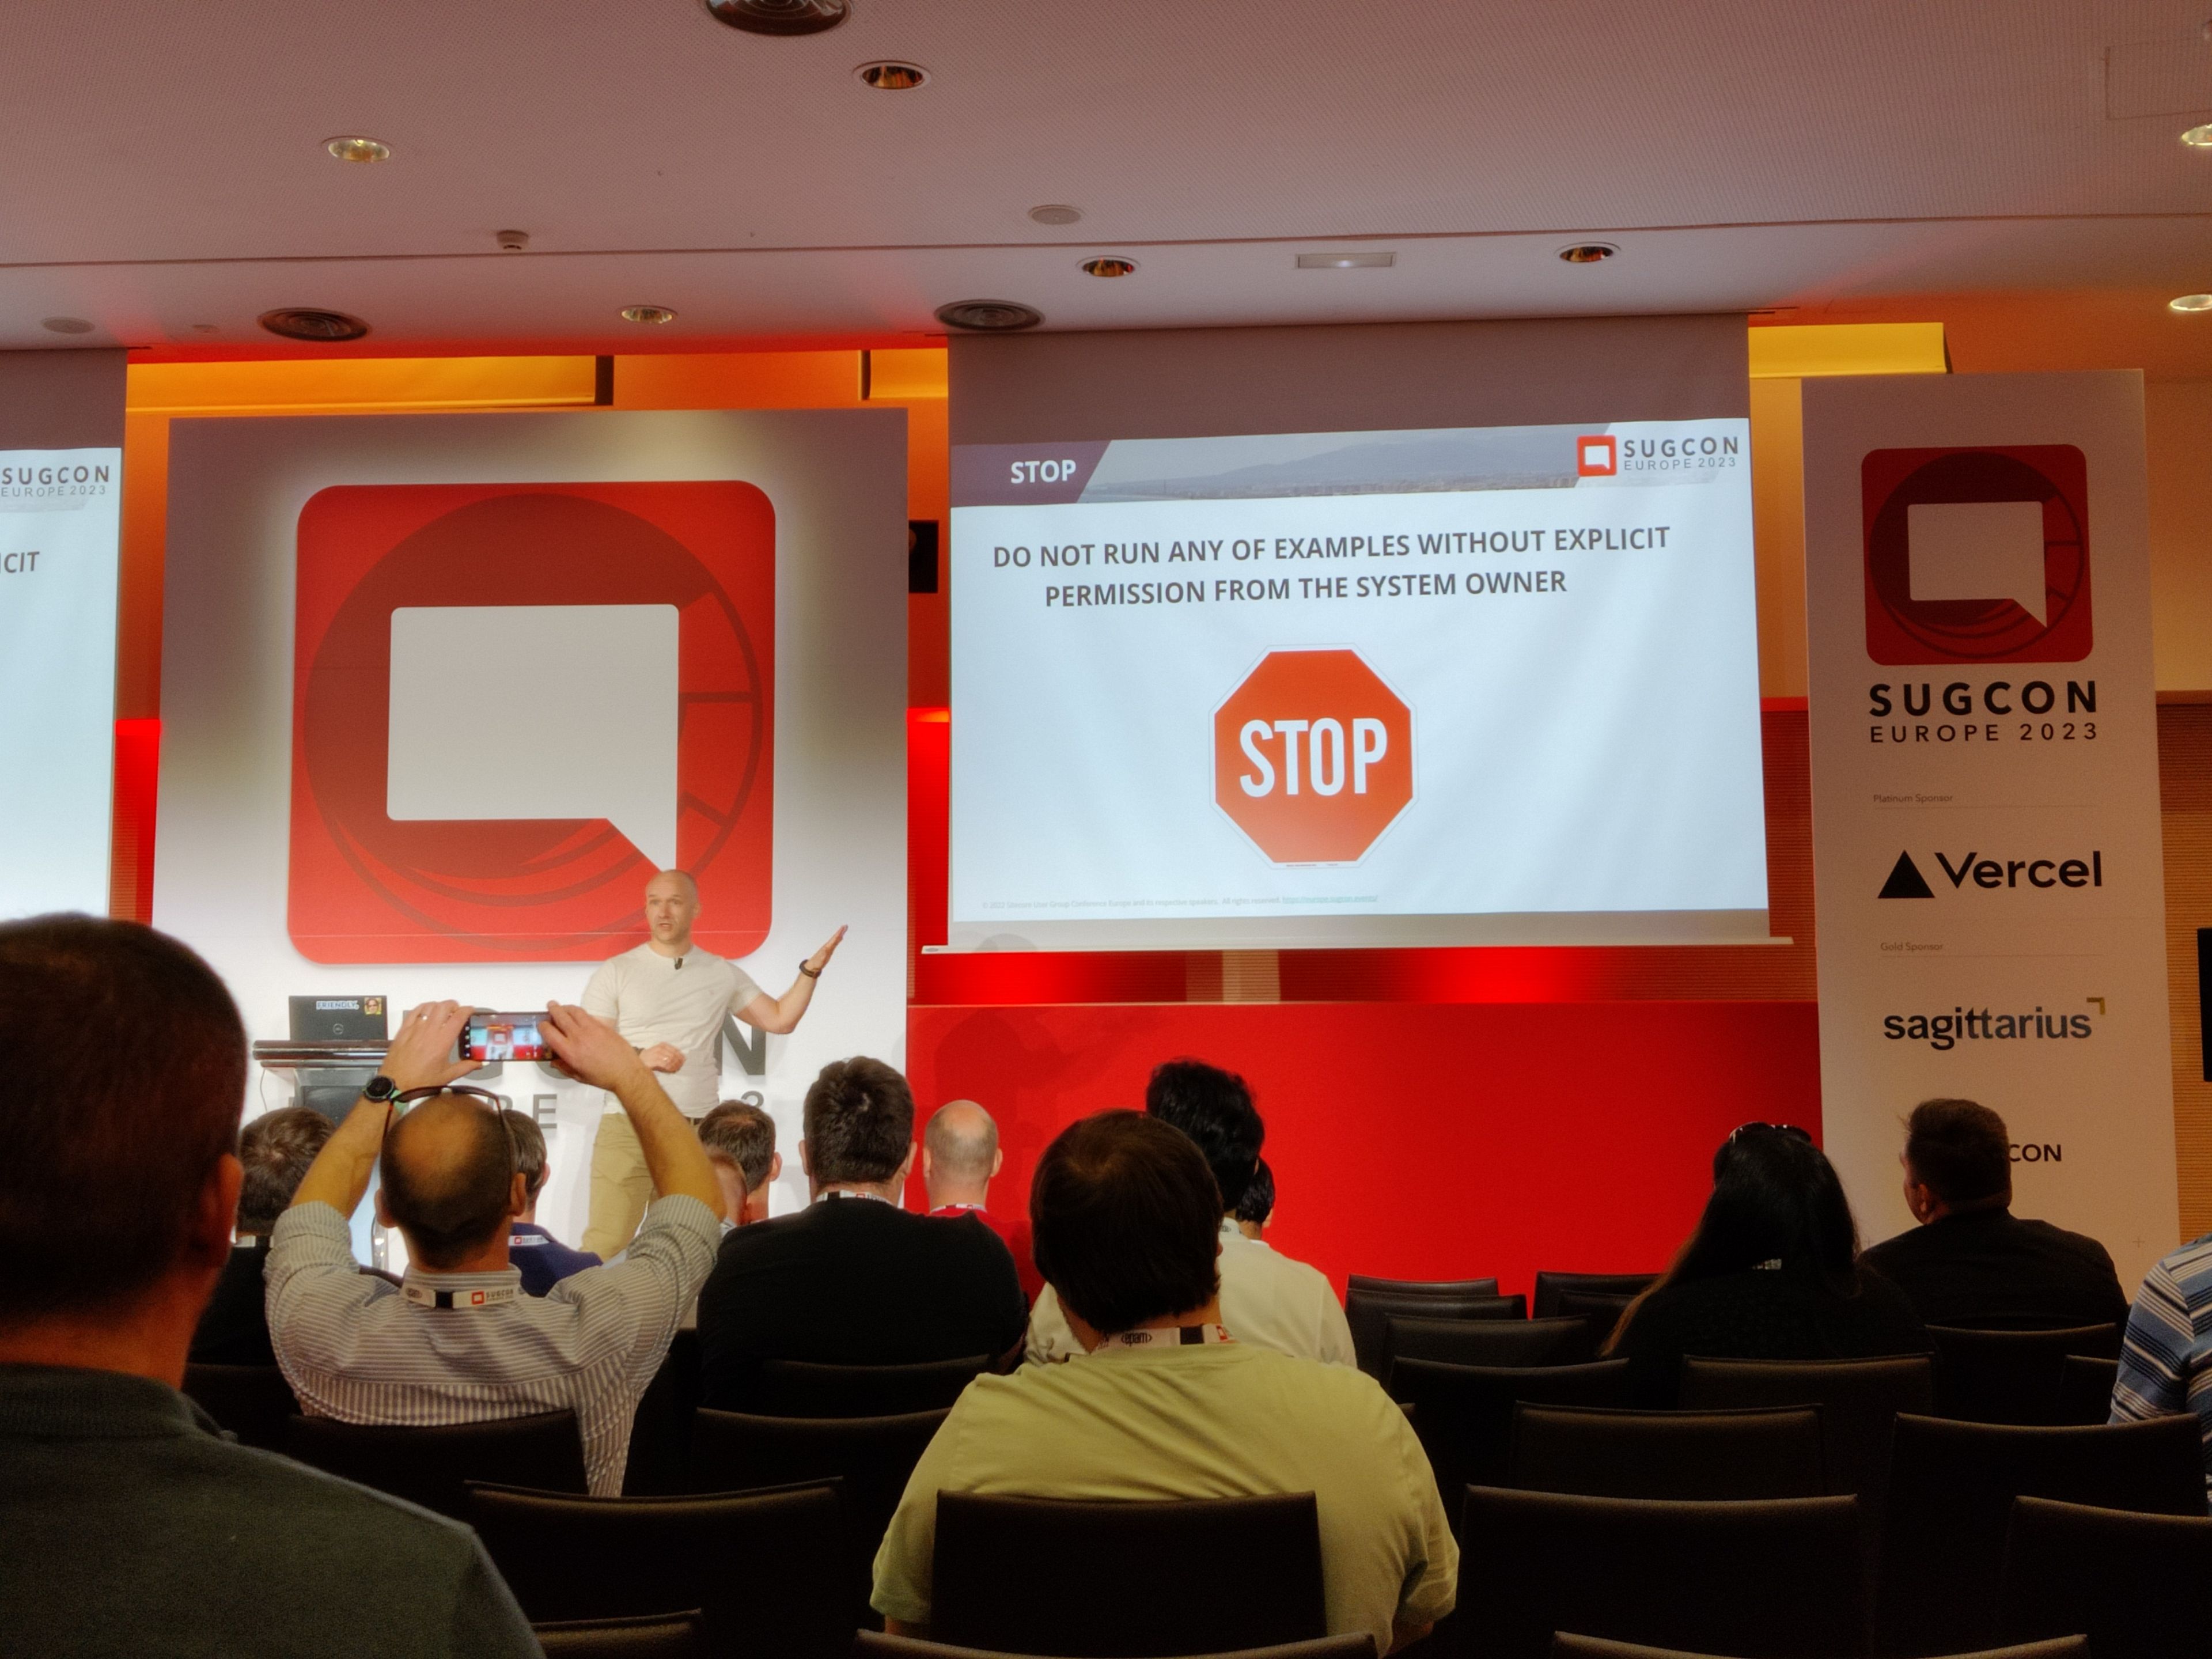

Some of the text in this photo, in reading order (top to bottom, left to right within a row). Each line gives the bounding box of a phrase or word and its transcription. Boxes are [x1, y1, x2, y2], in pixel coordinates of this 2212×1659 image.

[1624, 437, 1738, 459] SUGCON
[1, 465, 109, 485] SUGCON
[1010, 459, 1077, 484] STOP
[1624, 457, 1736, 471] EUROPE 2023
[1, 484, 106, 498] EUROPE 2023
[994, 527, 1671, 568] DO NOT RUN ANY OF EXAMPLES WITHOUT EXPLICIT
[0, 551, 40, 574] CIT
[1046, 570, 1567, 608] PERMISSION FROM THE SYSTEM OWNER
[1868, 680, 2097, 717] SUGCON
[1870, 722, 2097, 744] EUROPE 2023
[1239, 718, 1388, 798] STOP
[1873, 793, 1953, 805] Platinum Sponsor
[1934, 850, 2103, 889] Vercel
[1071, 900, 1107, 908] Conference
[1108, 900, 1131, 908] Europe
[1880, 941, 1944, 953] Gold Sponsor
[1883, 1006, 2092, 1051] sagittarius
